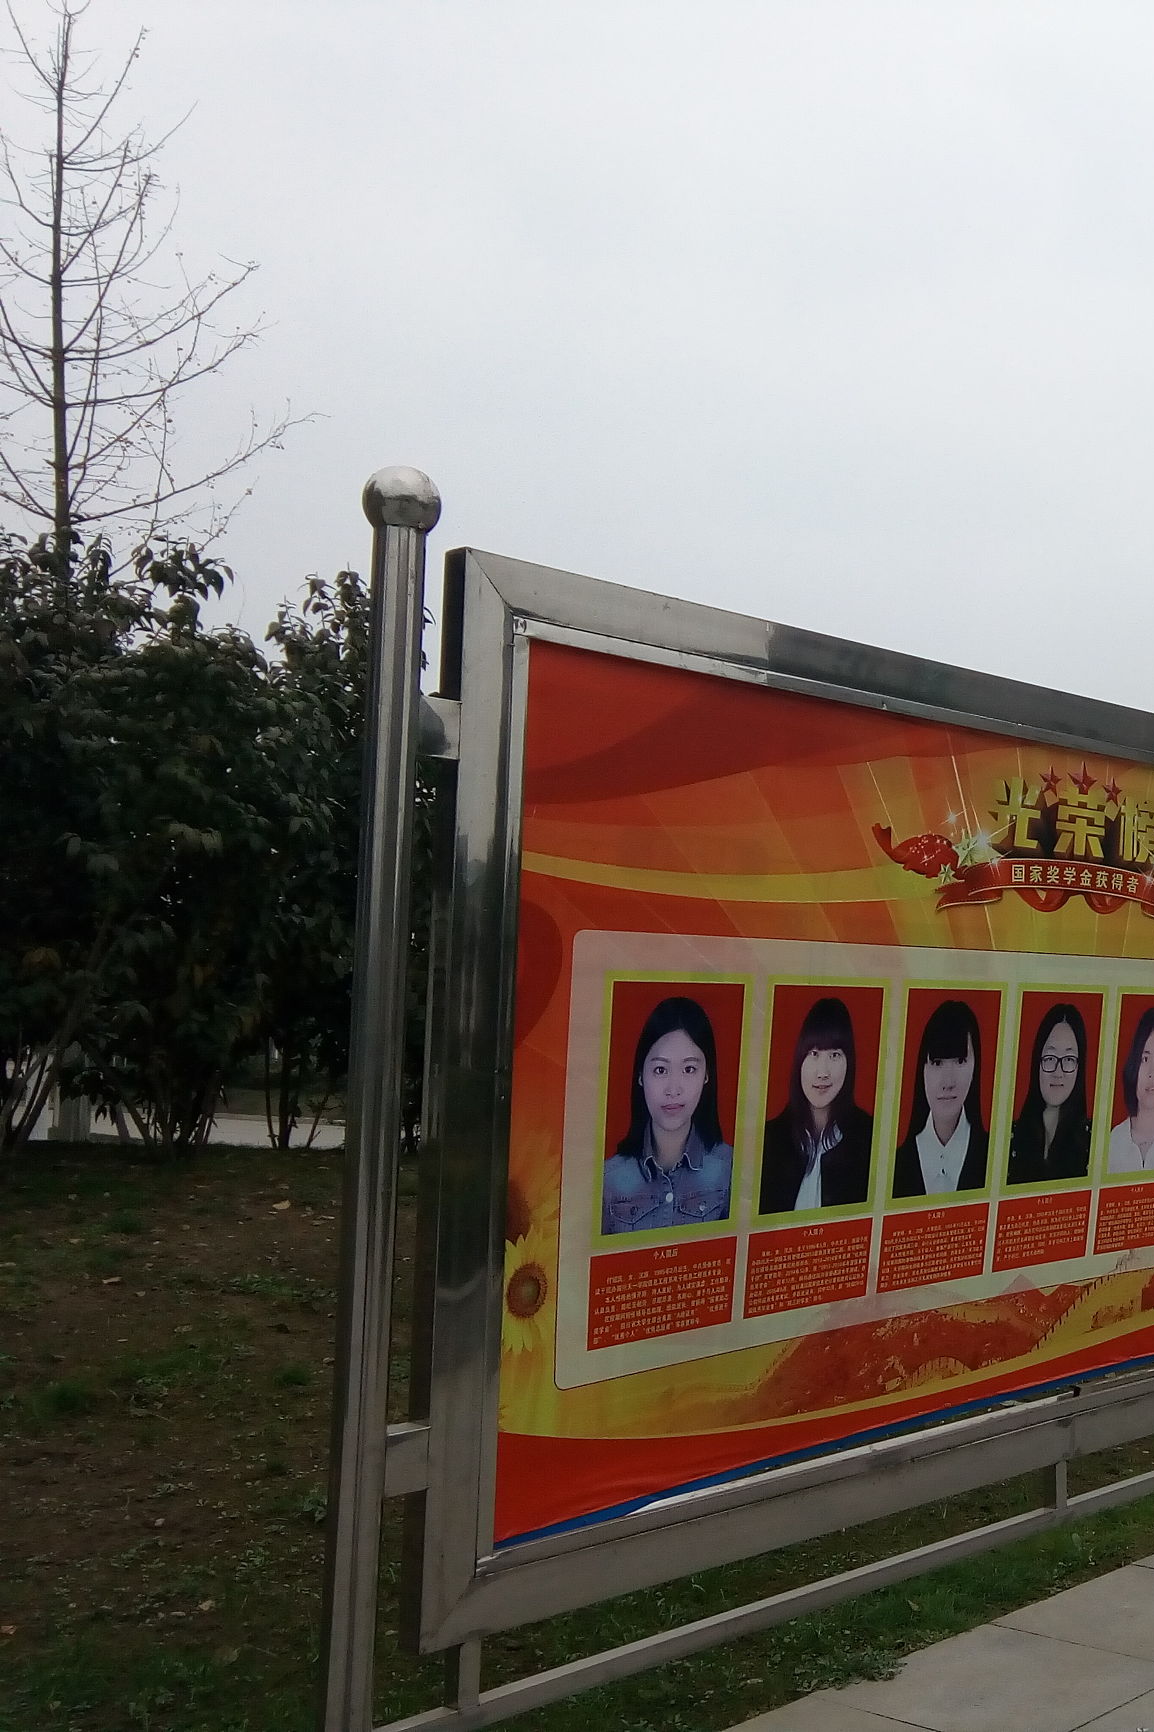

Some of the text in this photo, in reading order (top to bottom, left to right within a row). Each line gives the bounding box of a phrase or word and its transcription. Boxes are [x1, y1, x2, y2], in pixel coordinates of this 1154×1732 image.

[1011, 864, 1139, 894] 国家奖学金获得者
